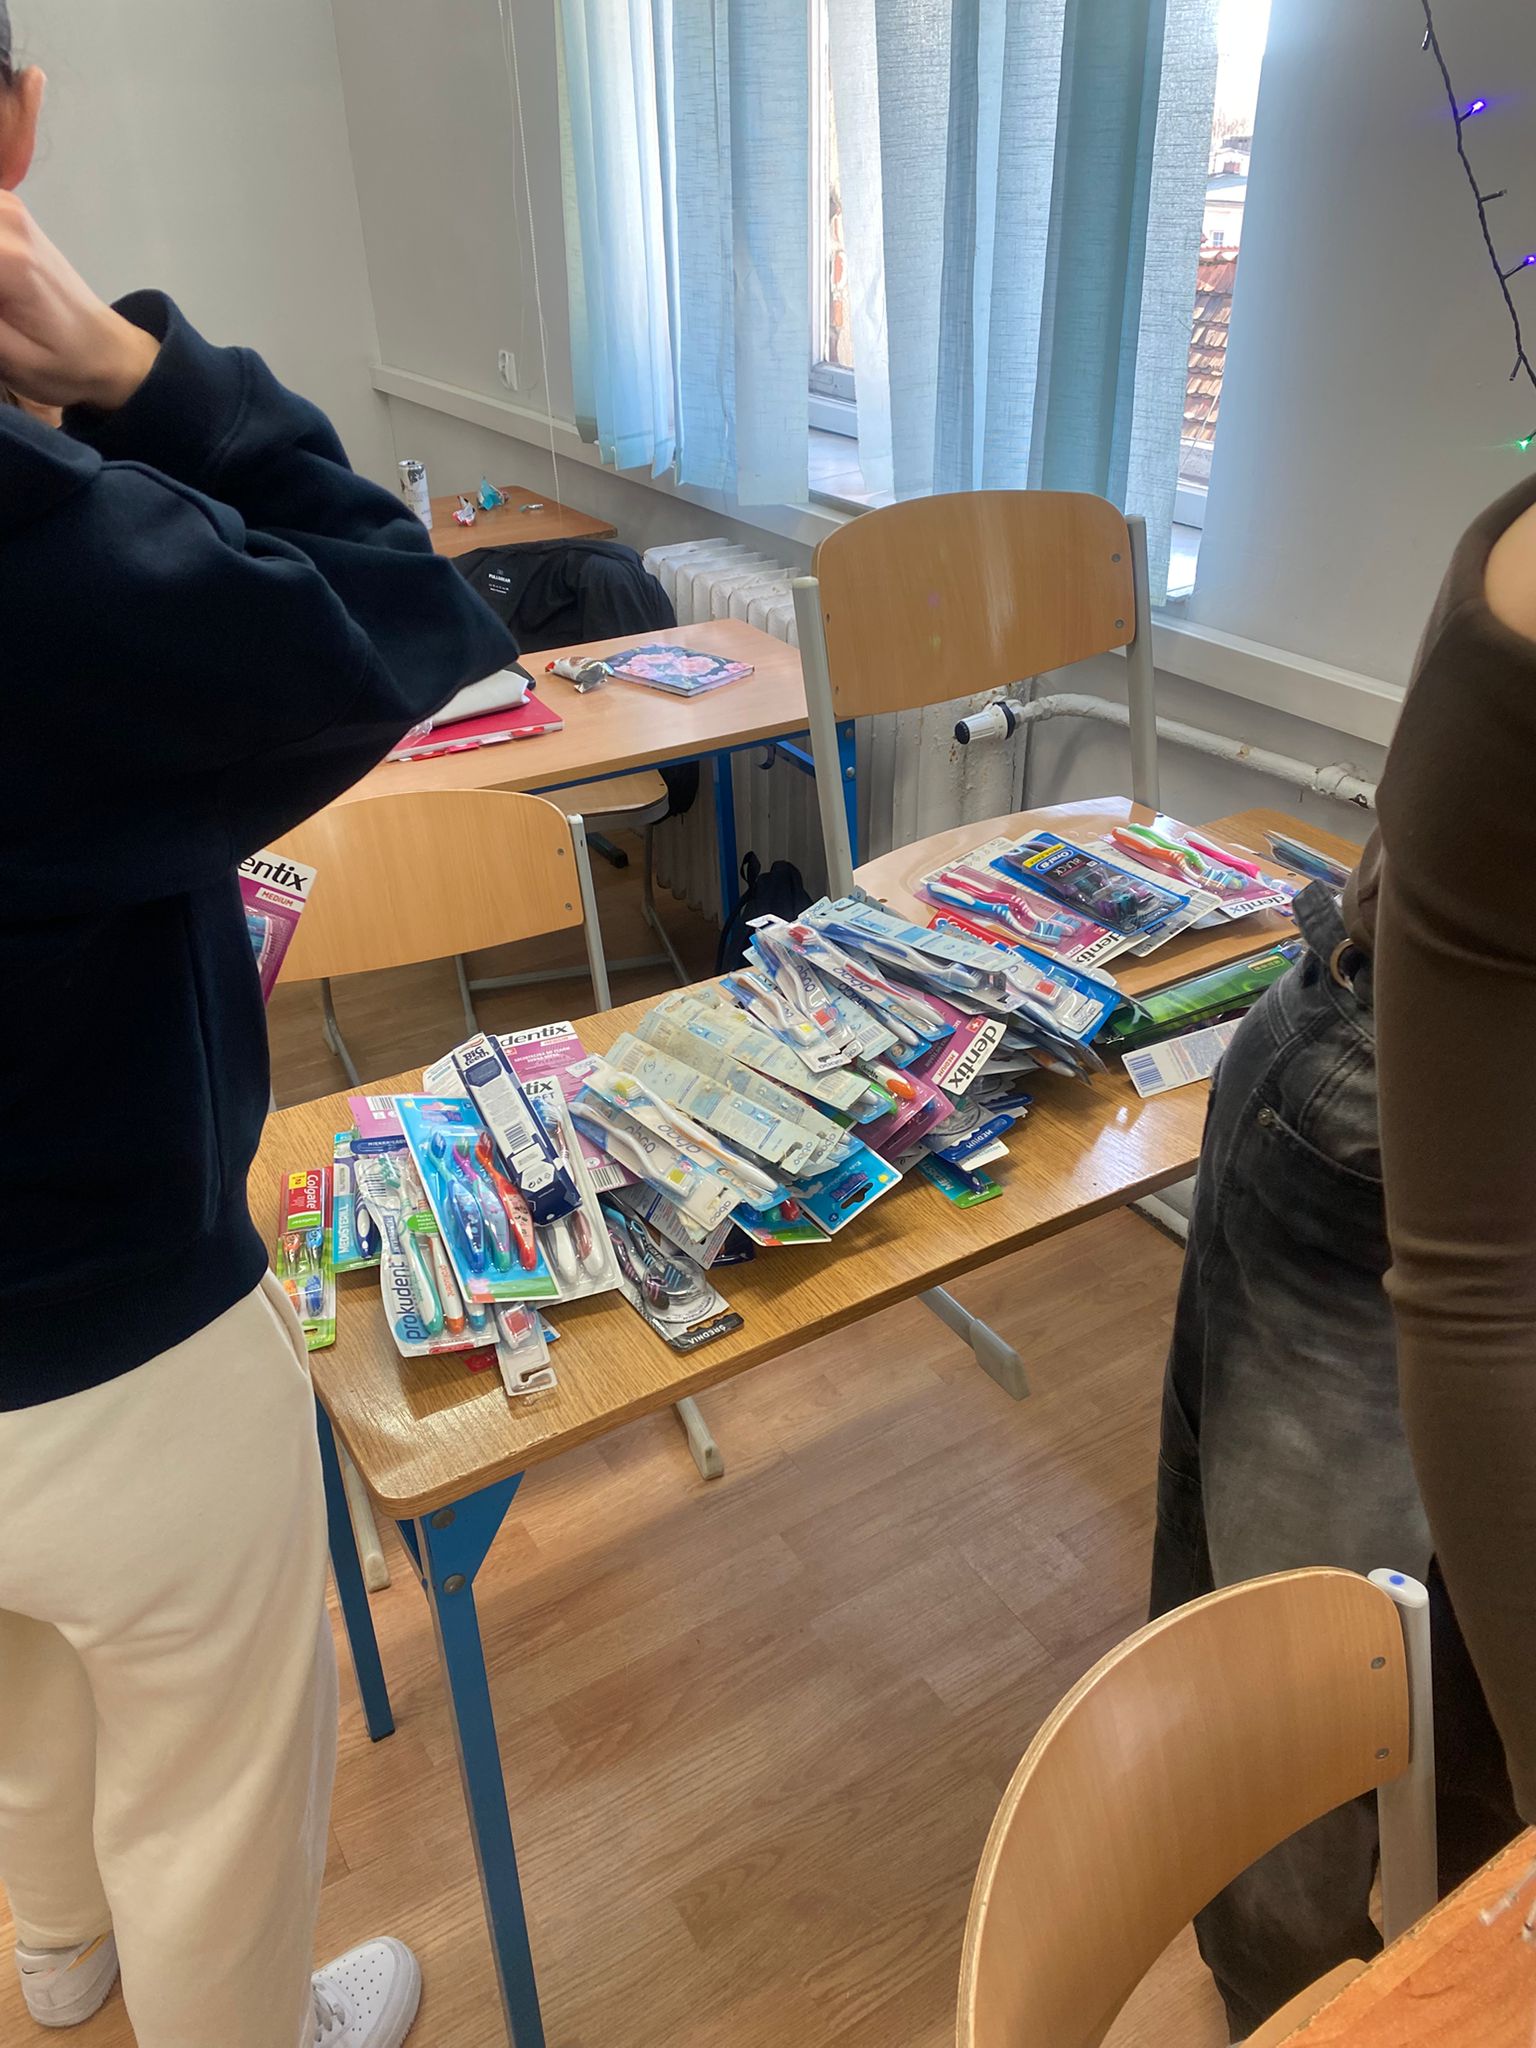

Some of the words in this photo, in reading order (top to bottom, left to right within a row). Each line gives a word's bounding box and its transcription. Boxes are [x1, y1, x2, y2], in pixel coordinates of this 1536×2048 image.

[1041, 850, 1072, 869] Oral-B
[1056, 858, 1082, 876] BLACK
[239, 856, 308, 891] entix
[261, 890, 294, 907] MEDIUM
[1232, 895, 1286, 915] dentix
[501, 1026, 568, 1048] dentix
[938, 1053, 955, 1077] MEDIUM
[948, 1025, 998, 1089] dentix
[524, 1081, 553, 1096] tix
[966, 1129, 994, 1149] MEDIUM
[920, 1162, 955, 1190] MEDIST
[306, 1174, 319, 1209] Colgate
[440, 1264, 456, 1297] prokudent
[389, 1261, 431, 1340] prokudent
[687, 1324, 727, 1345] ŚREDNIA
